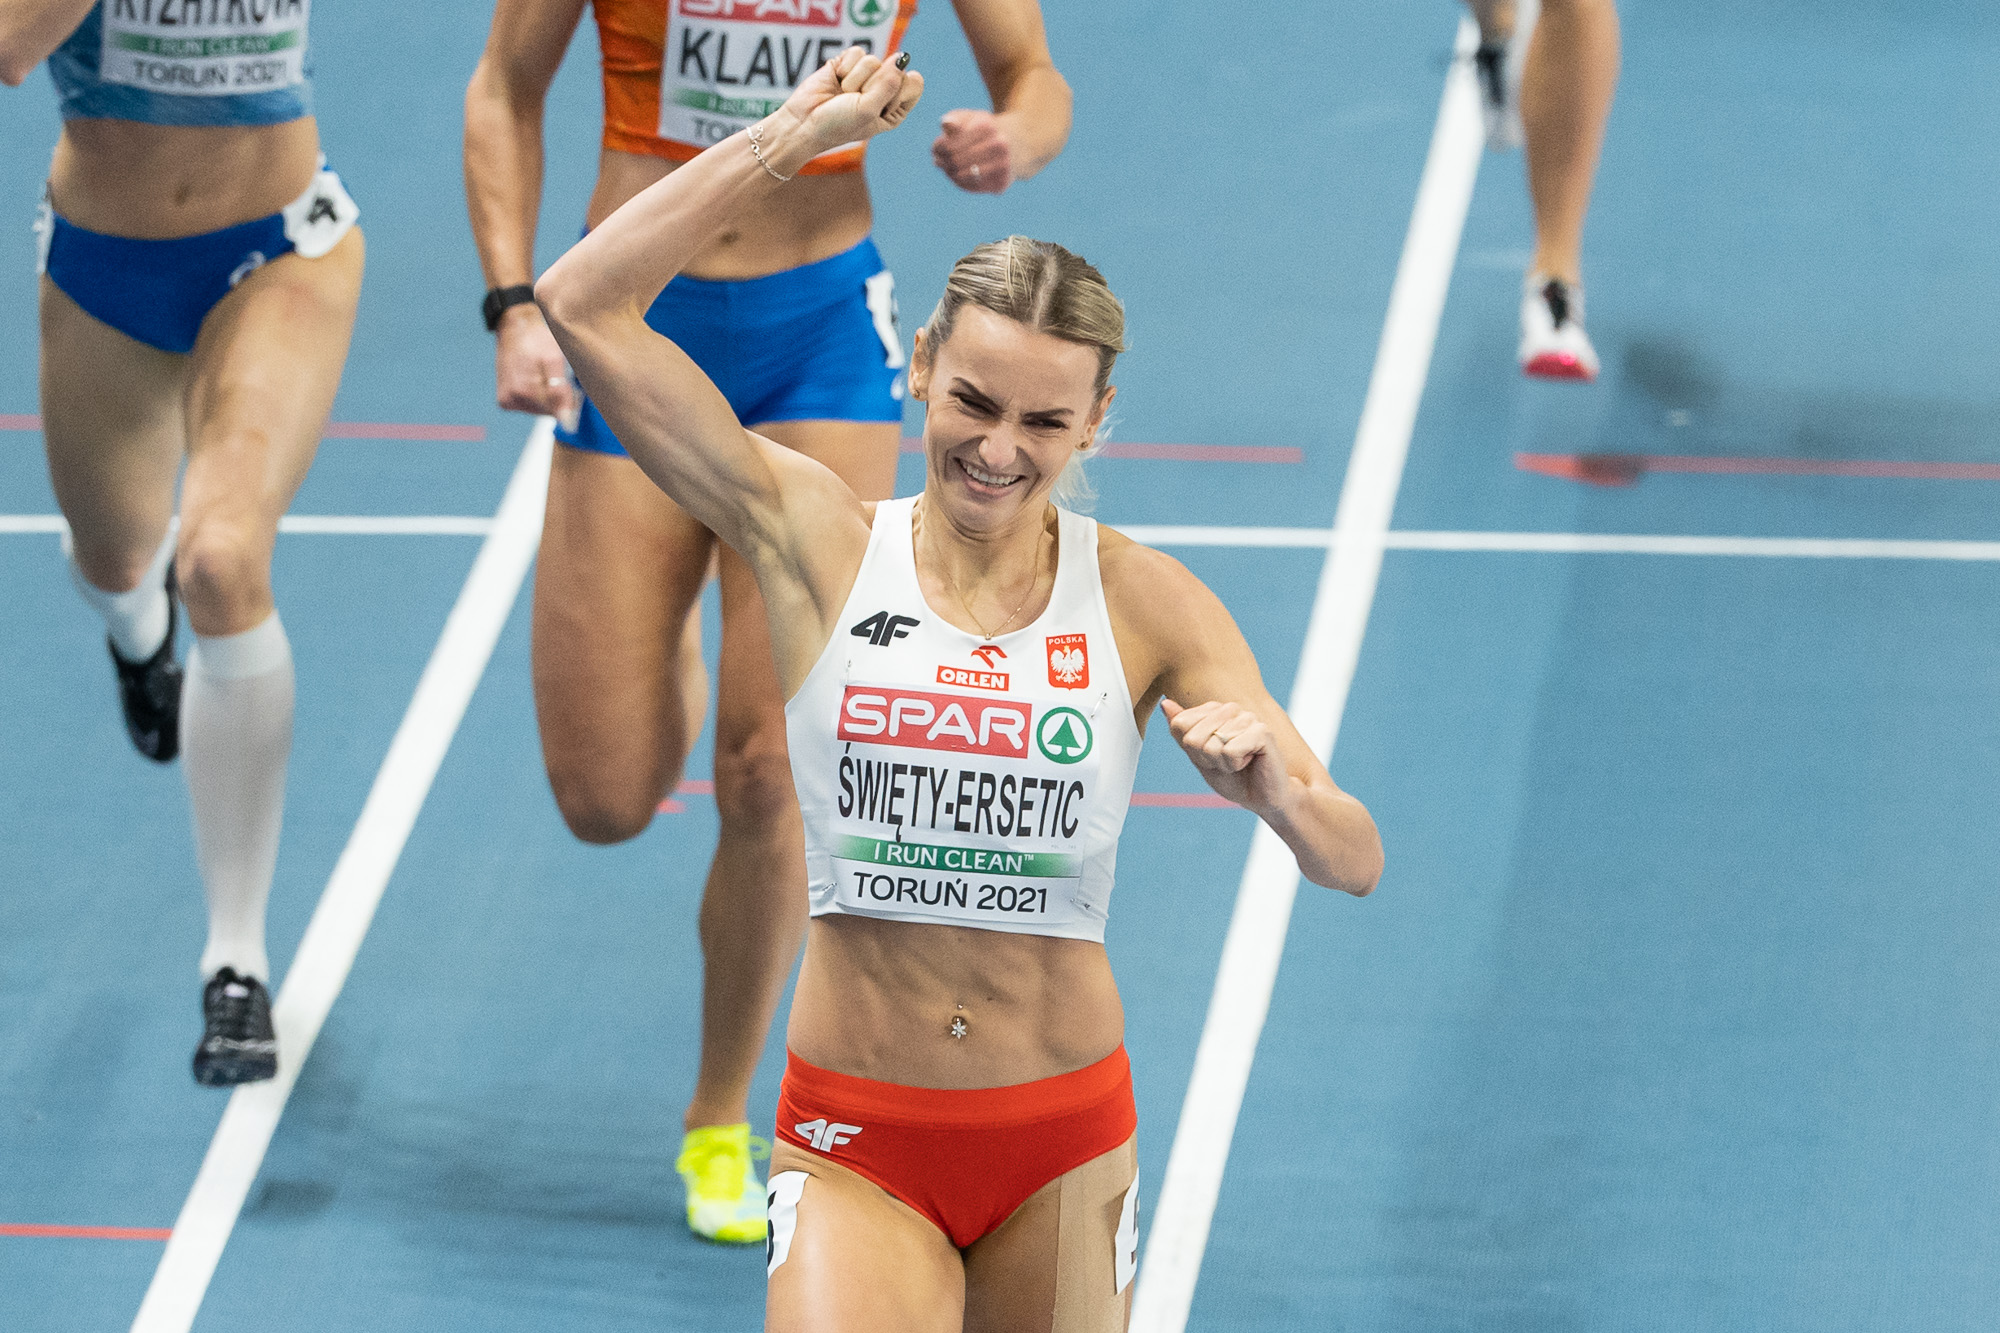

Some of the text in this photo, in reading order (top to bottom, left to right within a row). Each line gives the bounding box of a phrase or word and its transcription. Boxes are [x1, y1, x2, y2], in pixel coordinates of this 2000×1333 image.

[850, 610, 921, 647] 4F
[1048, 636, 1084, 645] POLSKA
[940, 668, 1006, 689] ORLEN
[844, 693, 1026, 750] SPAR
[838, 742, 1084, 843] ŚWIĘTY-ERSETIC
[874, 841, 881, 860] I
[886, 843, 938, 866] RUN
[853, 871, 1047, 913] TORUŃ 2021
[794, 1118, 863, 1153] 4F
